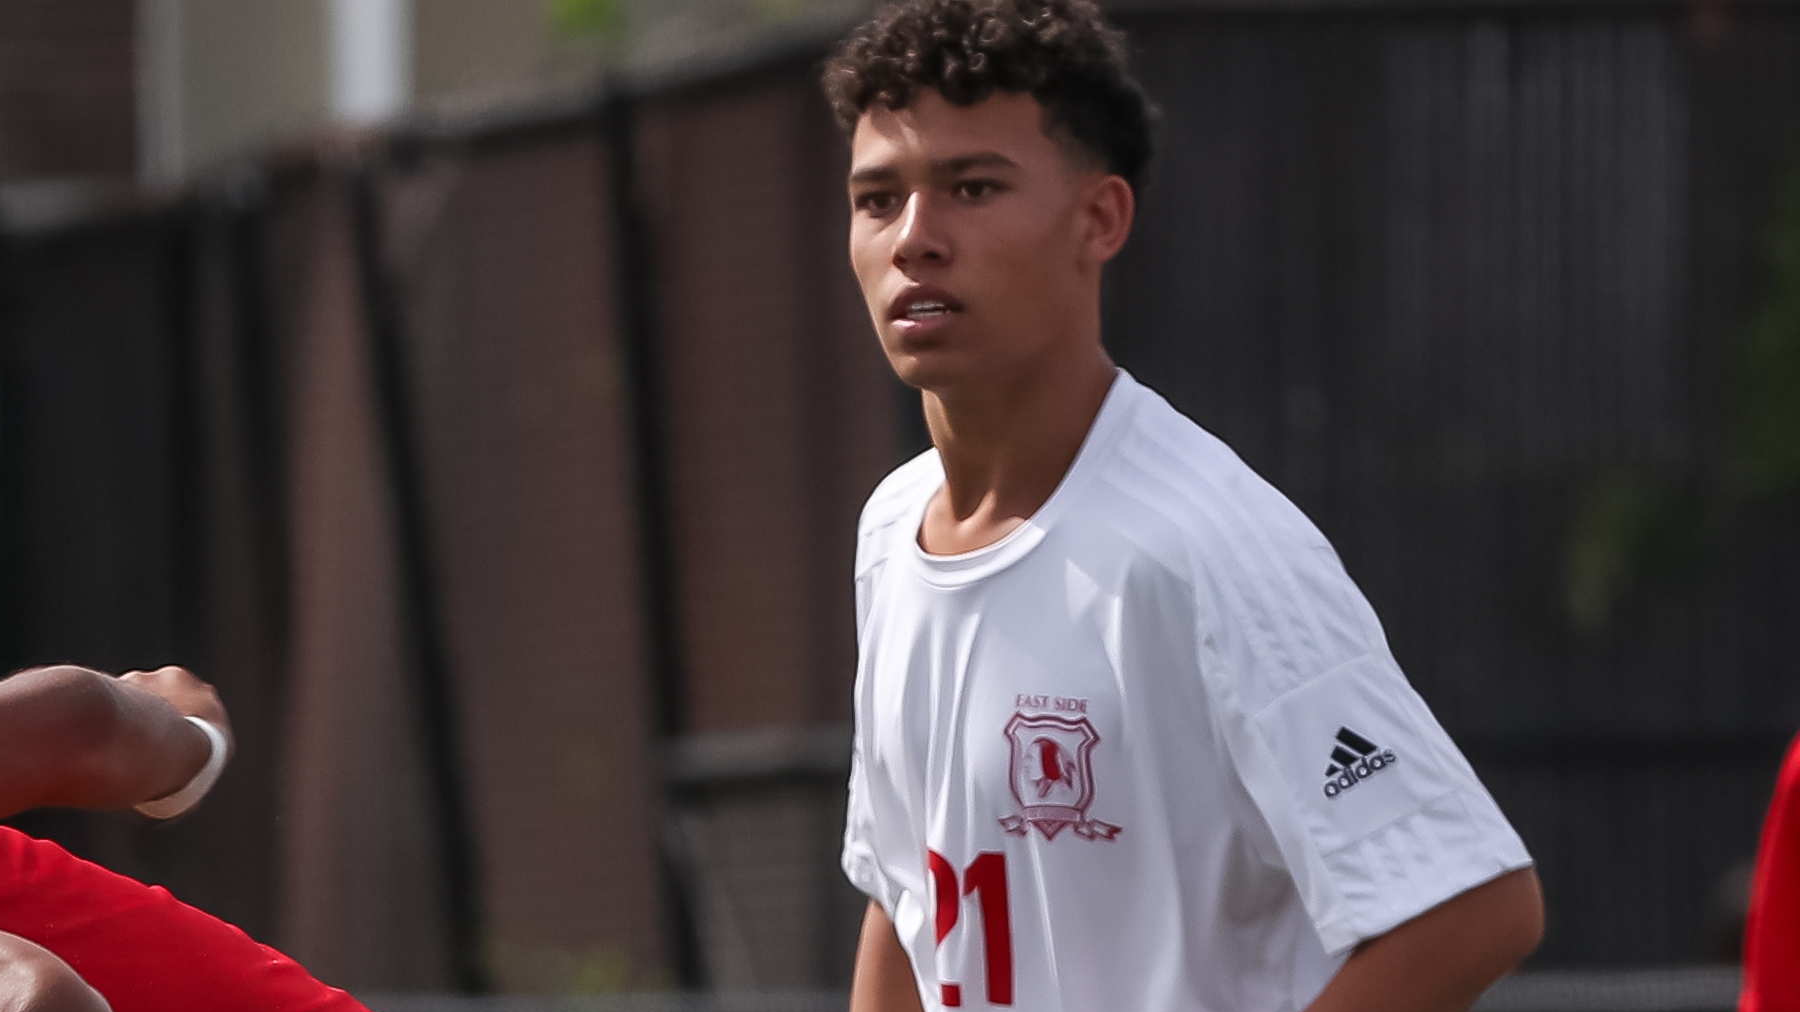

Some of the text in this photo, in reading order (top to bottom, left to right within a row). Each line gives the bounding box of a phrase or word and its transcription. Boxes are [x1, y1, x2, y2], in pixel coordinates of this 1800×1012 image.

[1015, 693, 1088, 713] EAST SIDE
[1323, 749, 1396, 798] adidas
